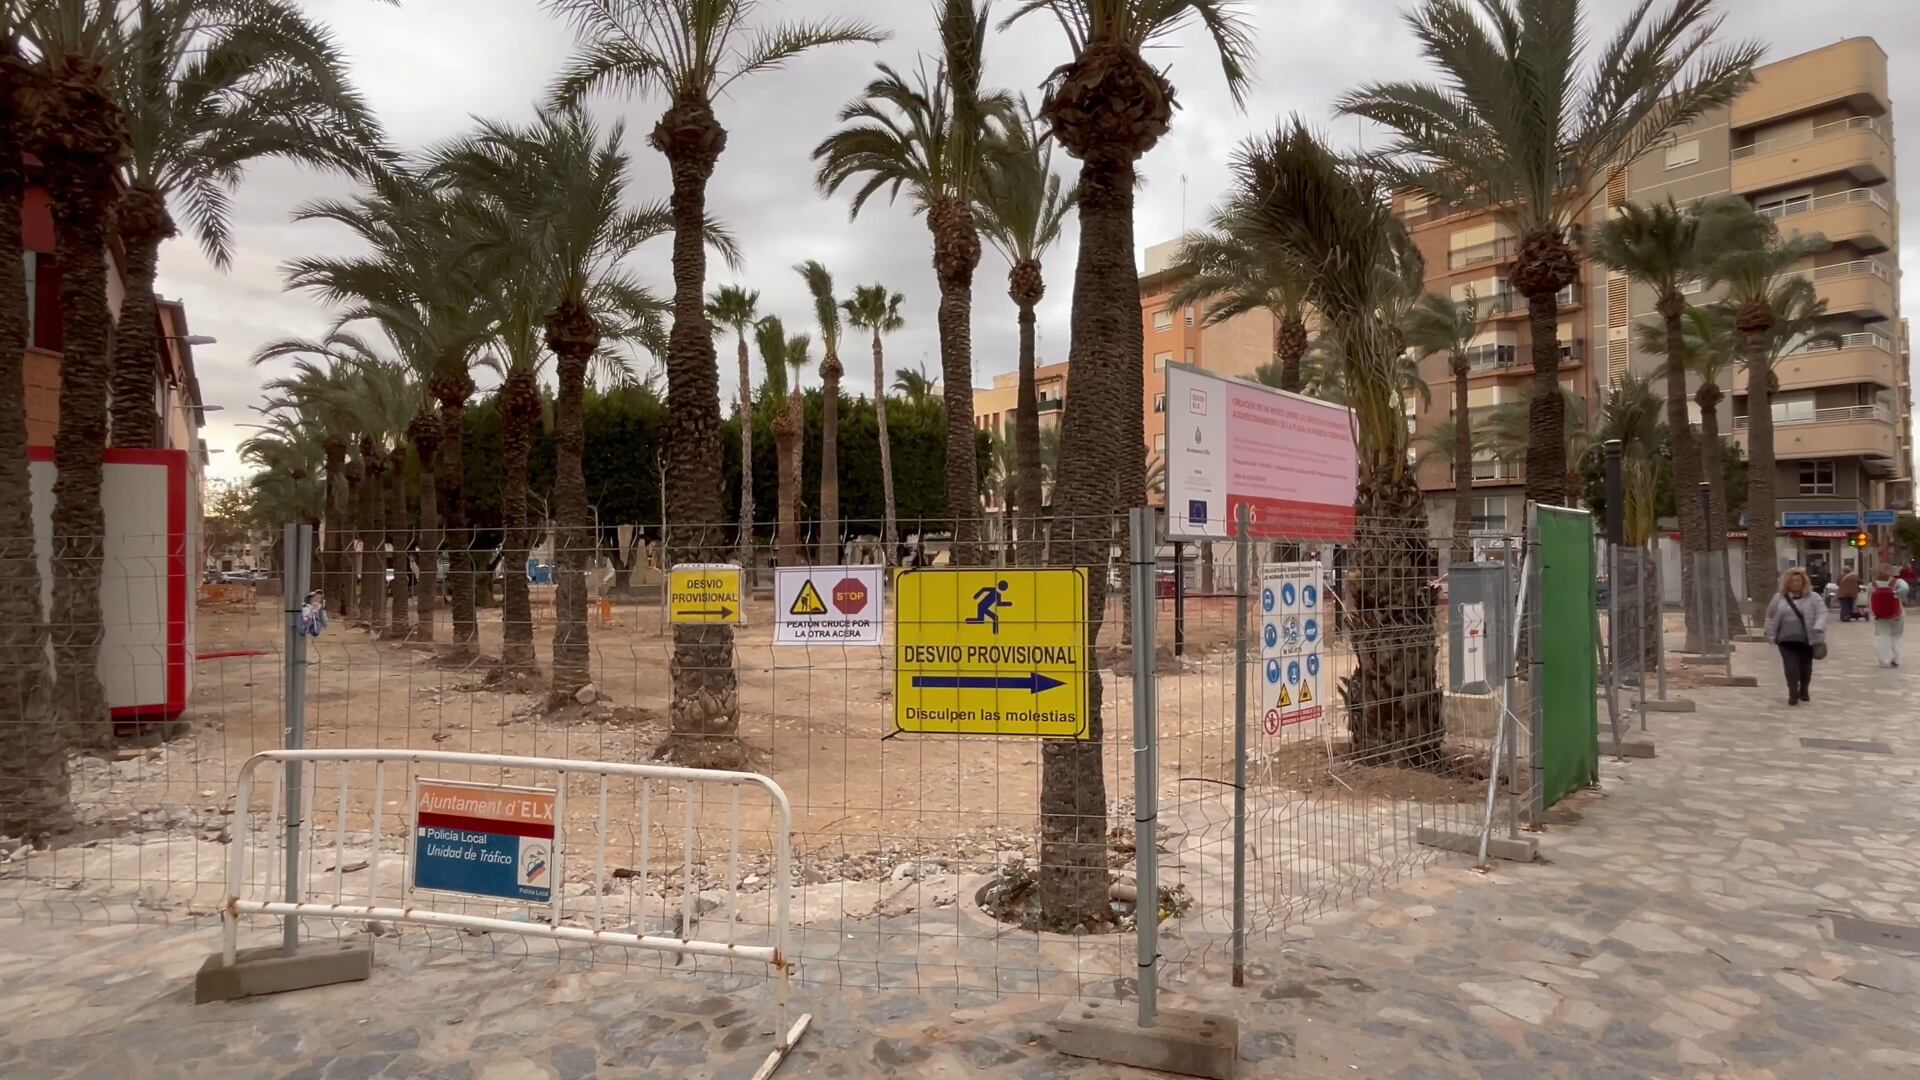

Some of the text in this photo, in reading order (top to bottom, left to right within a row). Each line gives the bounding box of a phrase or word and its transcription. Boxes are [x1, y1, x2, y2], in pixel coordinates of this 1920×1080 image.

[687, 579, 723, 589] DESVIO
[672, 592, 738, 603] PROVISIONAL
[836, 592, 864, 600] STOP
[821, 620, 850, 628] CRUCE
[852, 620, 870, 628] POR
[795, 629, 861, 638] LA OTRA ACERA
[905, 646, 1077, 664] DESVIO PROVISIONAL
[906, 707, 1076, 723] Disculpen las molestias
[420, 791, 500, 815] Ajuntament
[427, 828, 487, 844] Policía Local
[427, 843, 513, 865] Unidad de Tráfico
